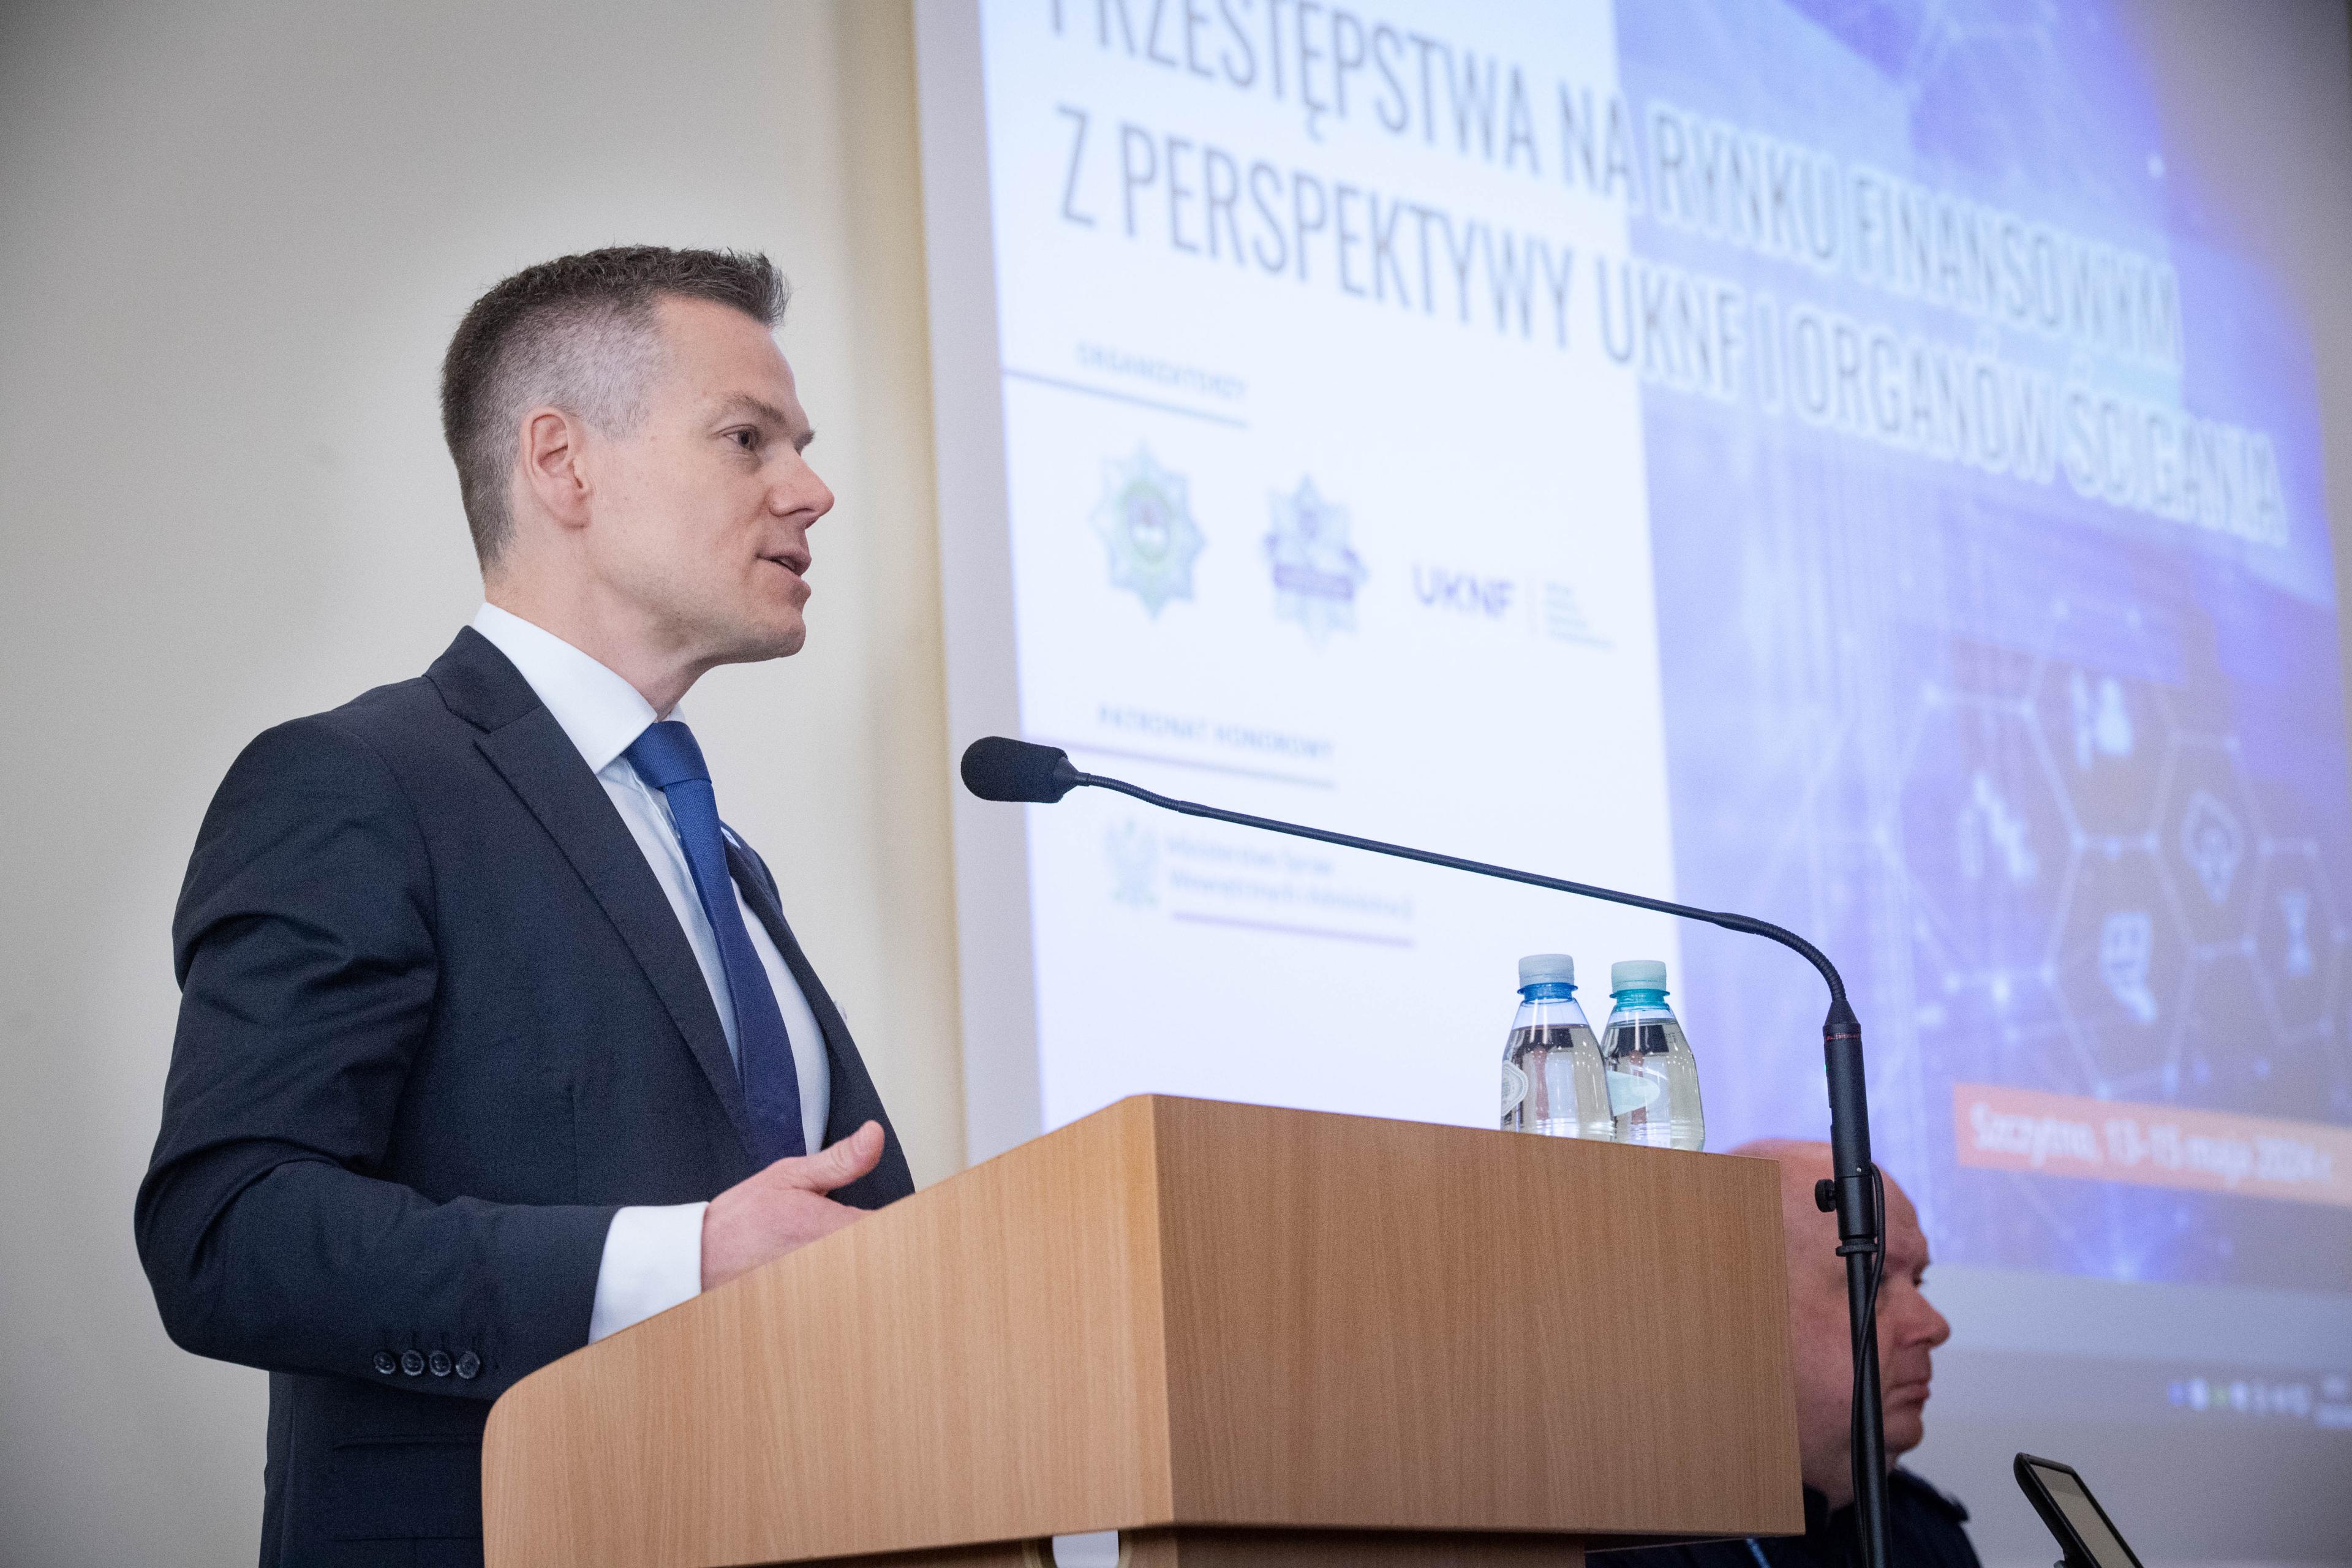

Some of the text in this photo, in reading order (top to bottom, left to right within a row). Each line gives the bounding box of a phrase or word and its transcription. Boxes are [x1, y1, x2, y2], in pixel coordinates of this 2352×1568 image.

[1049, 0, 2180, 368] ZESTĘPSTWA NA RYNKU FINANSOWYM
[1055, 103, 2286, 541] Z PERSPEKTYWY UKNF I ORGANÓW ŚCIGANIA
[1412, 563, 1514, 619] UKNF
